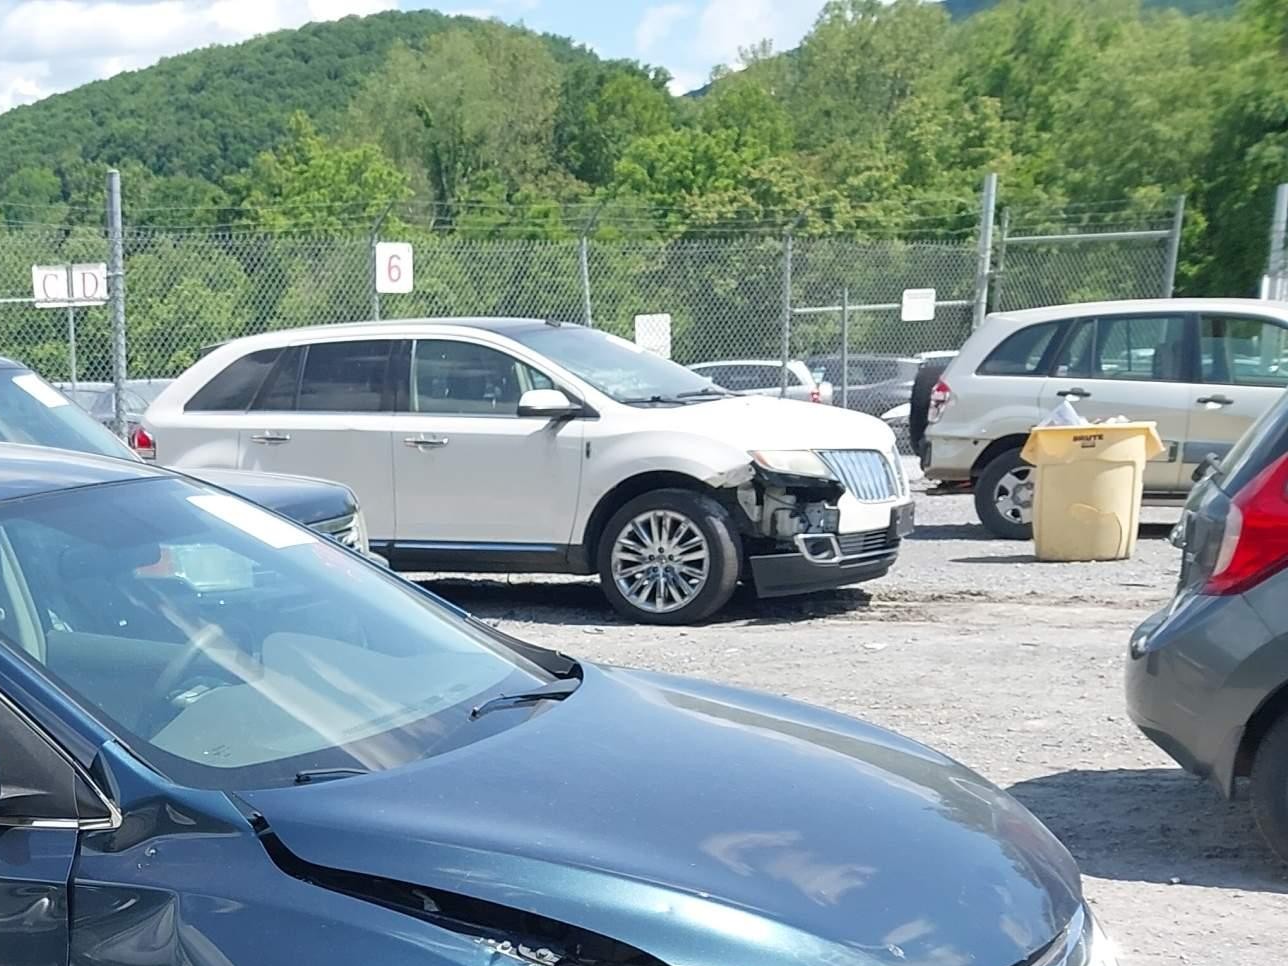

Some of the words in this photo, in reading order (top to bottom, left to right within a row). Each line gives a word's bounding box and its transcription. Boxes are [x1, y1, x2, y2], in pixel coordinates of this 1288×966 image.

[387, 254, 402, 282] 6
[42, 273, 59, 300] C
[81, 272, 99, 299] D
